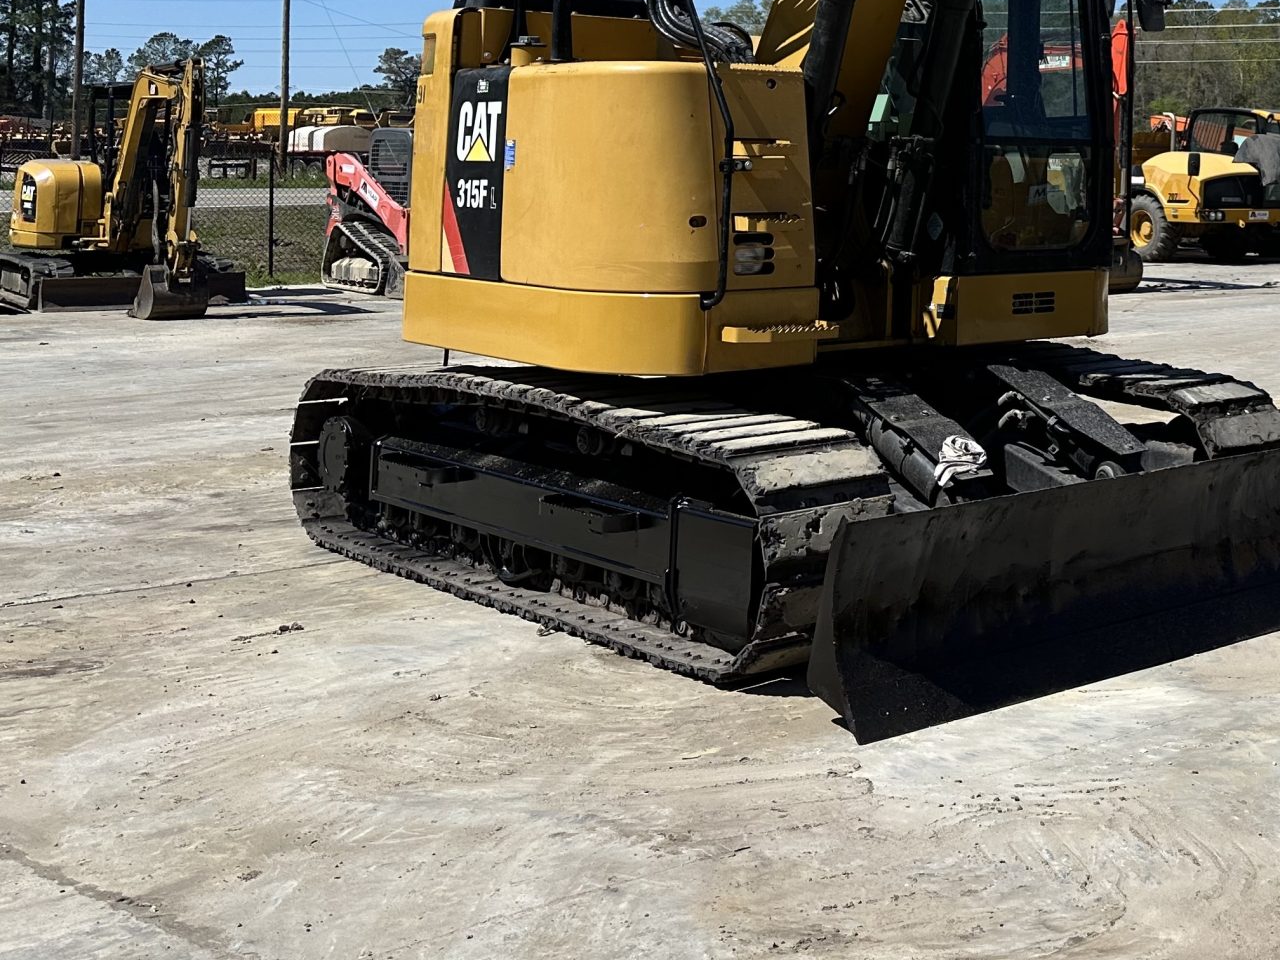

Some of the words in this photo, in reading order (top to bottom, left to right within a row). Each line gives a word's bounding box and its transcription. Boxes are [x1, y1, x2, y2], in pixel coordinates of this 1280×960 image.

[457, 101, 502, 161] CAT
[22, 184, 36, 201] CAT
[457, 179, 488, 209] 315F
[490, 187, 496, 209] L
